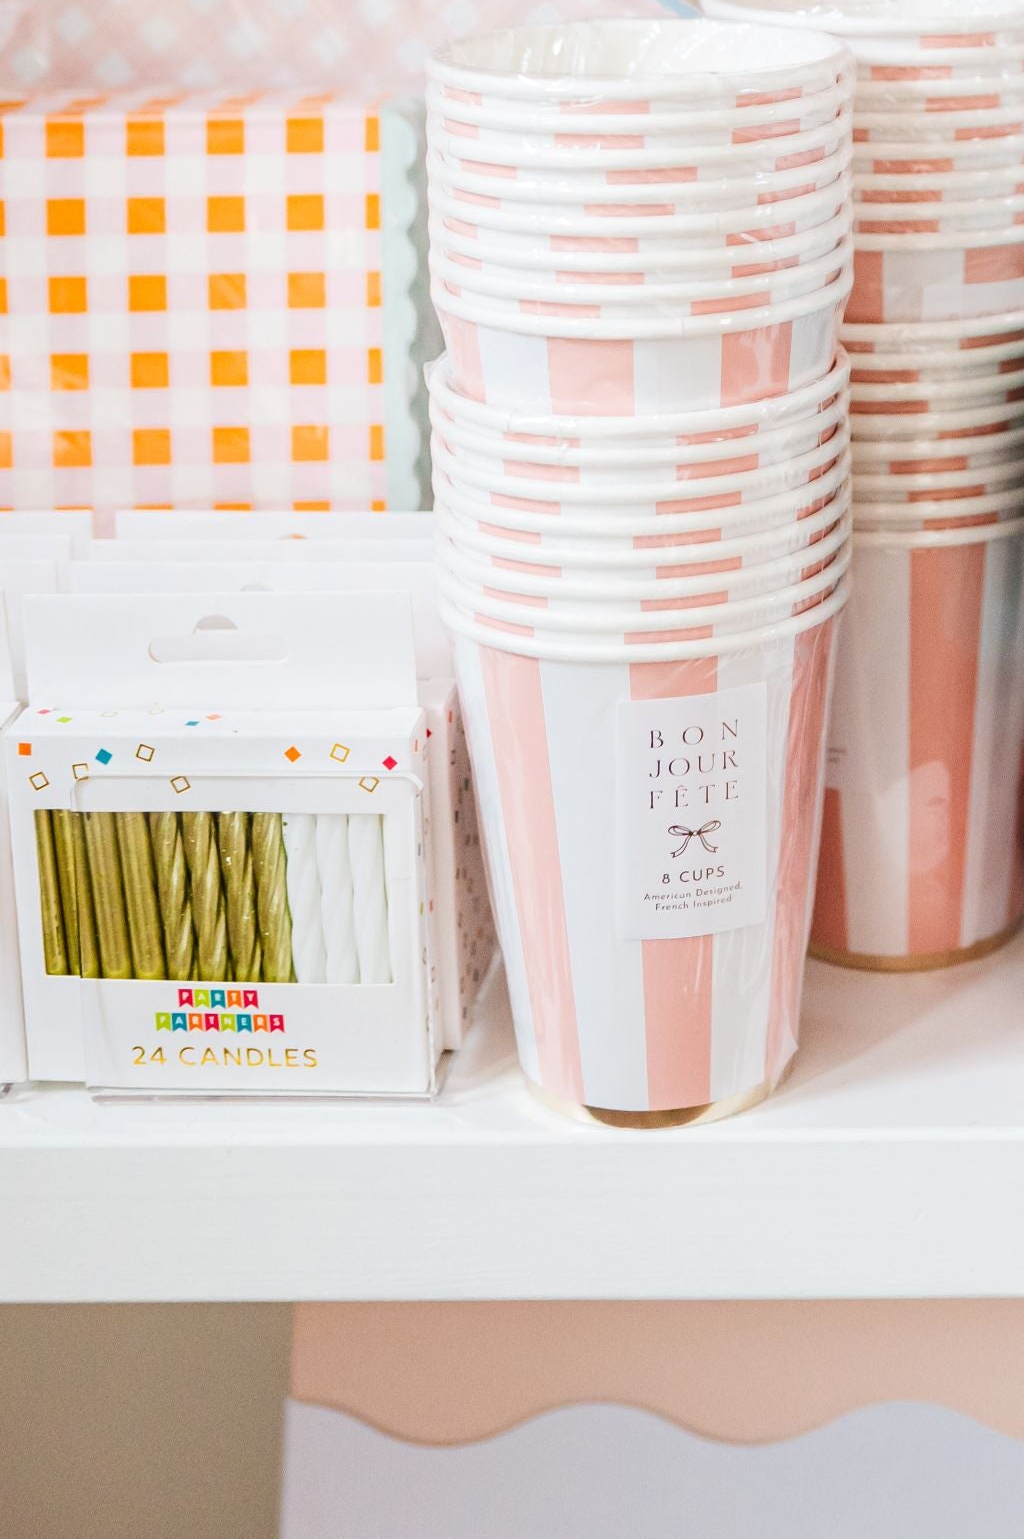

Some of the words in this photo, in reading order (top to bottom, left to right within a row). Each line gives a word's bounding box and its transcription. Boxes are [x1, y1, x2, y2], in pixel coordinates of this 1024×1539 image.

[649, 718, 738, 749] BON
[649, 750, 738, 779] JOUR
[649, 779, 739, 809] FÊTE
[661, 873, 671, 885] 8
[679, 865, 725, 883] CUPS
[643, 891, 692, 901] American
[655, 901, 689, 912] French
[693, 893, 732, 910] Inspired
[181, 991, 255, 1003] PARTY
[159, 1015, 281, 1028] PARTNERS
[131, 1045, 167, 1066] 24
[178, 1046, 318, 1068] CANDLES
